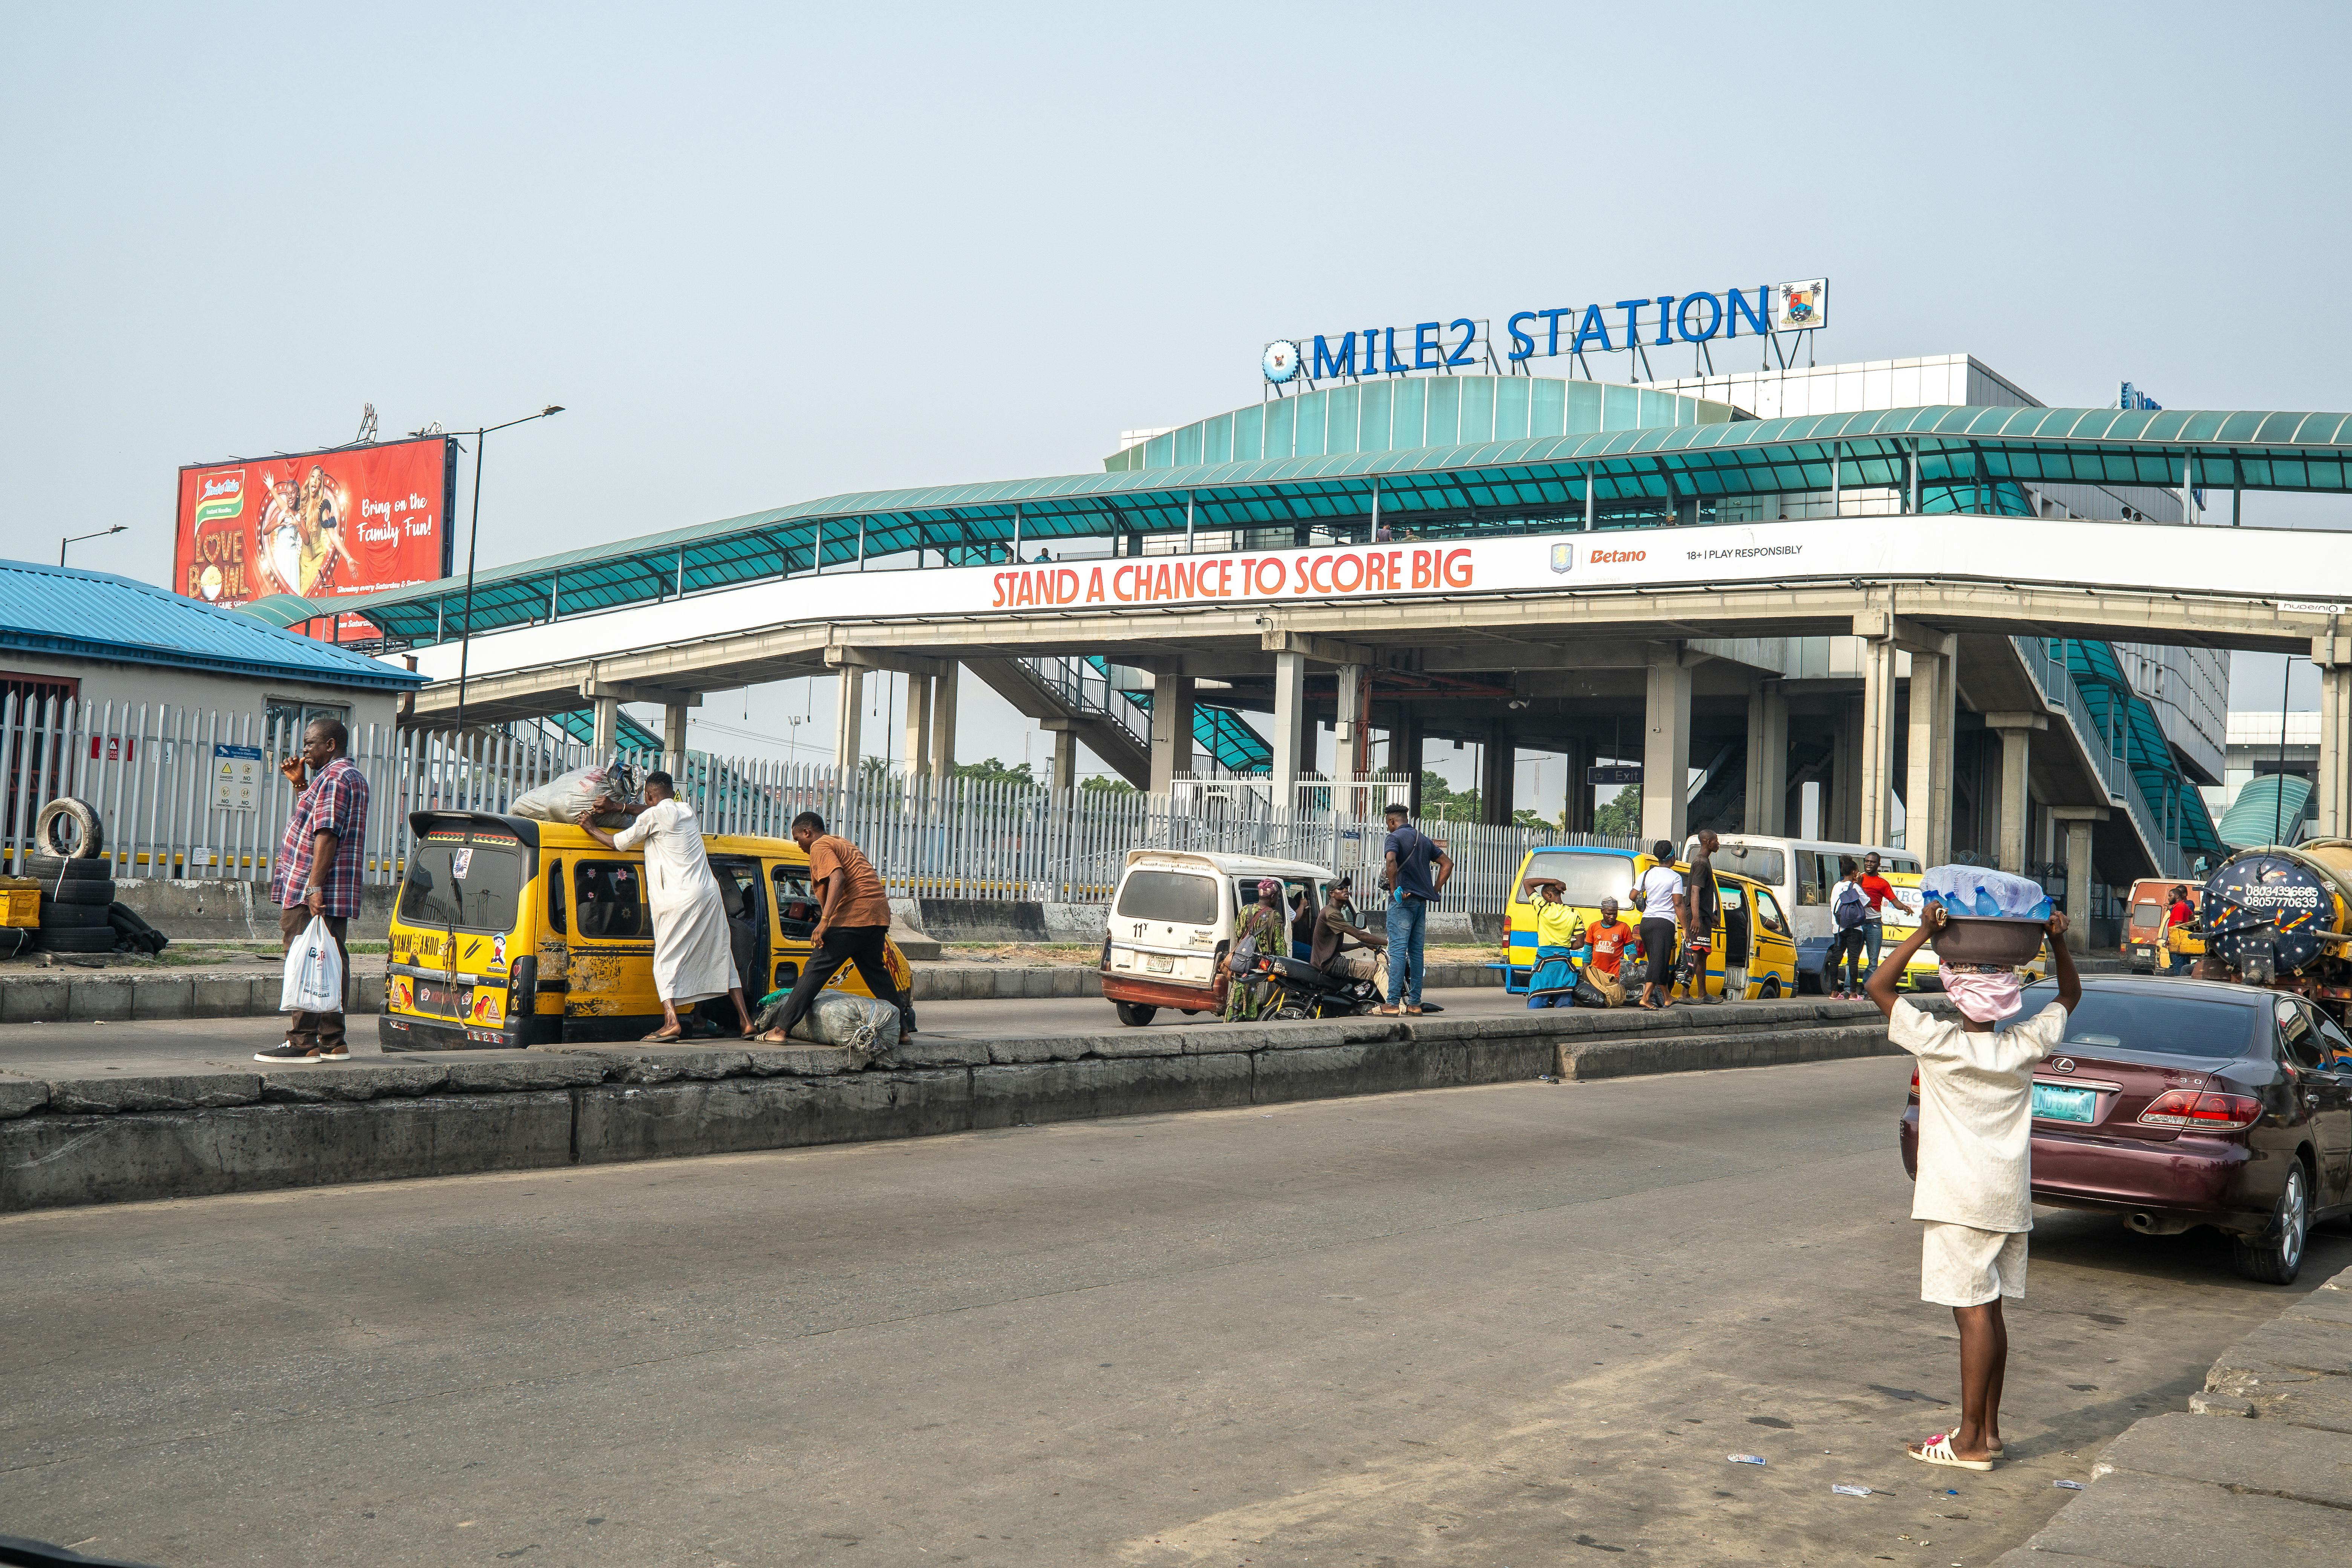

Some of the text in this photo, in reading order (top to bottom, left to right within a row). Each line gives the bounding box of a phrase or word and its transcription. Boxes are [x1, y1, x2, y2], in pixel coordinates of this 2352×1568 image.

[1314, 285, 1768, 379] MILE2 STATION
[199, 479, 239, 501] Indomie
[362, 492, 427, 522] Bring on the
[356, 514, 432, 548] Family Fun!
[196, 530, 243, 563] LOVE
[1591, 550, 1646, 563] Betano
[1709, 550, 1733, 559] PLAY
[1735, 545, 1802, 557] RESPONSIBLY
[337, 585, 359, 593] Showing
[993, 549, 1473, 607] STAND A CHANCE TO SCORE BIG
[1615, 770, 1638, 781] Exit
[2245, 896, 2317, 908] 08057770639
